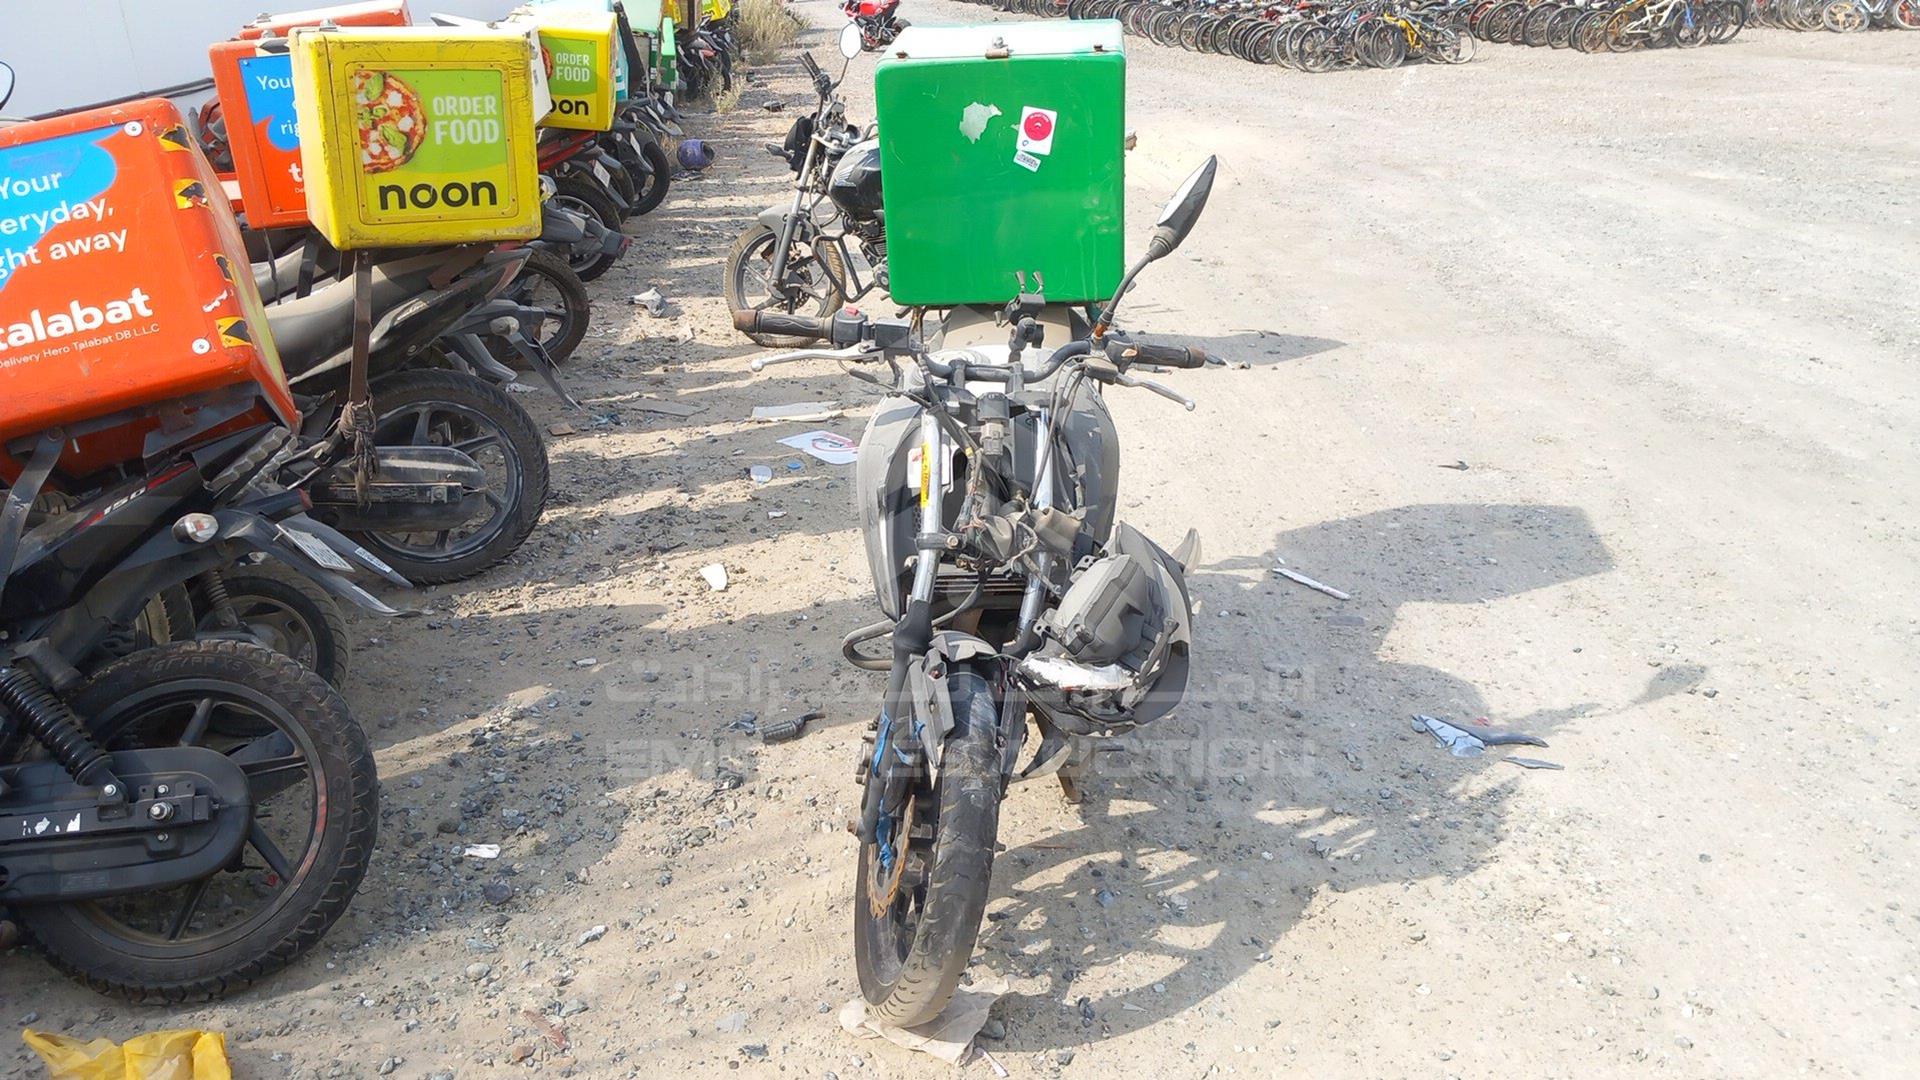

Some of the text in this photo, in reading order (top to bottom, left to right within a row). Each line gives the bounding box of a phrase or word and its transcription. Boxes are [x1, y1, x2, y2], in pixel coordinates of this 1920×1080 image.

[556, 52, 590, 66] ORDER
[256, 75, 293, 90] You
[556, 66, 590, 82] FOOD
[432, 95, 497, 116] ORDER
[434, 118, 500, 145] FOOD
[379, 181, 498, 210] noon
[49, 229, 128, 260] away
[43, 345, 70, 359] Hero
[73, 335, 114, 351] Talabat
[115, 329, 132, 341] DB
[104, 486, 146, 516] 150
